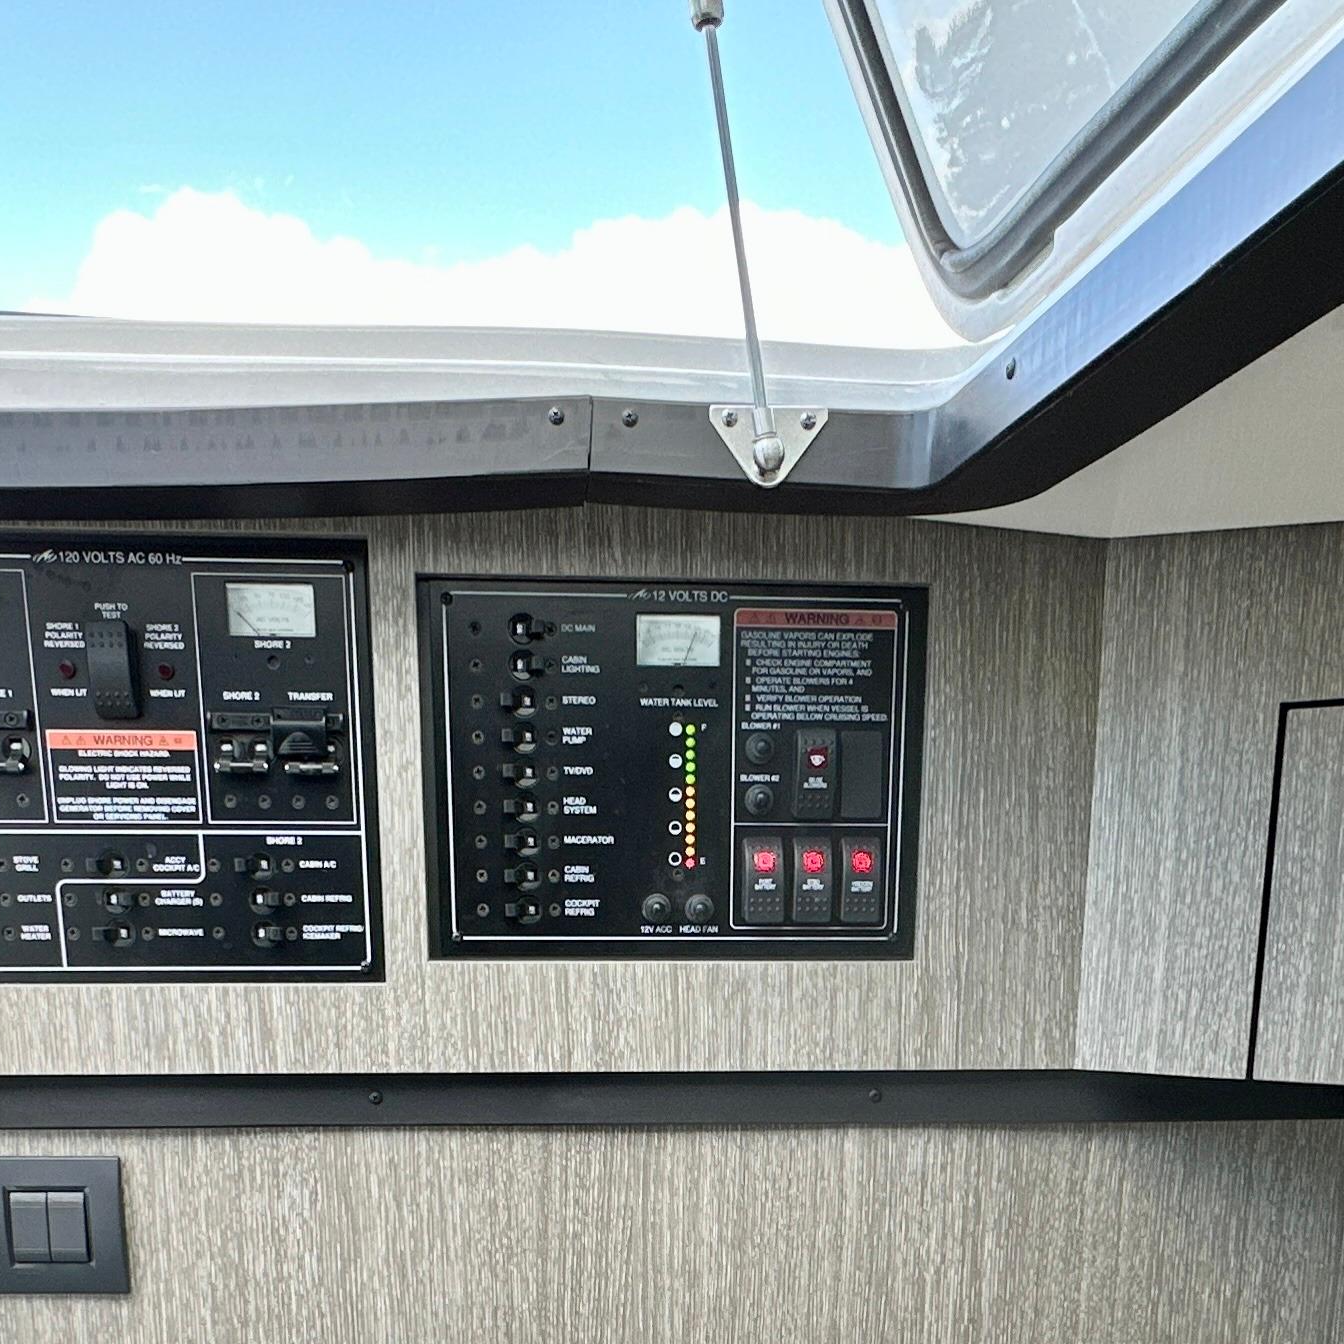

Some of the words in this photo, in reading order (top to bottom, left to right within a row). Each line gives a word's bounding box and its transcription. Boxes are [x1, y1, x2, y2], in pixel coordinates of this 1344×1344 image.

[59, 552, 79, 563] 120
[83, 552, 125, 564] VOLTS
[128, 553, 145, 564] AC
[148, 553, 163, 564] 60
[166, 553, 182, 565] Hz
[653, 591, 665, 600] 12
[669, 591, 708, 601] VOLTS
[710, 592, 728, 601] DC
[117, 603, 128, 611] TO
[784, 613, 849, 624] WARNING
[45, 631, 83, 639] POLARITY
[144, 633, 183, 641] POLARITY
[784, 632, 816, 640] VAPORS
[836, 633, 873, 641] EXPLODE
[44, 640, 85, 648] REVERSED
[254, 640, 284, 649] SHORE
[286, 641, 291, 649] 2
[741, 640, 786, 648] RESULTING
[842, 641, 868, 649] DEATH
[748, 649, 781, 657] BEFORE
[782, 649, 822, 657] STARTING
[756, 659, 783, 667] CHECK
[784, 659, 812, 667] ENGINE
[561, 665, 600, 674] LIGHTING
[857, 668, 873, 676] AND
[792, 677, 830, 685] BLOWERS
[8, 689, 13, 698] 1
[51, 688, 74, 696] WHEN
[149, 689, 173, 698] WHEN
[223, 691, 252, 700] SHORE
[254, 692, 260, 701] 2
[288, 692, 333, 701] TRANSFER
[562, 696, 596, 705] STEREO
[640, 698, 669, 707] WATER
[671, 699, 692, 707] TANK
[693, 699, 718, 707] LEVEL
[818, 695, 862, 703] OPERATION
[773, 704, 806, 712] BLOWER
[831, 705, 859, 713] VESSEL
[751, 713, 795, 721] OPERATING
[796, 713, 823, 721] BELOW
[824, 713, 860, 721] CRUISING
[562, 727, 593, 736] WATER
[94, 736, 153, 746] WARNING
[562, 736, 587, 744] PUMP
[563, 766, 593, 775] TV/DVD
[563, 797, 586, 805] HEAD
[563, 806, 597, 814] SYSTEM
[266, 836, 296, 845] SHORE
[564, 836, 615, 845] MACERATOR
[164, 856, 186, 864] ACCY
[299, 860, 323, 869] CABIN
[153, 864, 186, 872] COCKPIT
[564, 866, 589, 874] CABIN
[564, 874, 594, 883] REFRIG
[17, 894, 52, 902] OUTLETS
[155, 897, 191, 906] CHARGER
[564, 908, 595, 916] REFRIG
[158, 928, 204, 937] MICROWAVE
[640, 925, 654, 933] 12V
[679, 925, 701, 933] HEAD
[702, 925, 718, 933] FAN
[20, 932, 52, 940] HEATER
